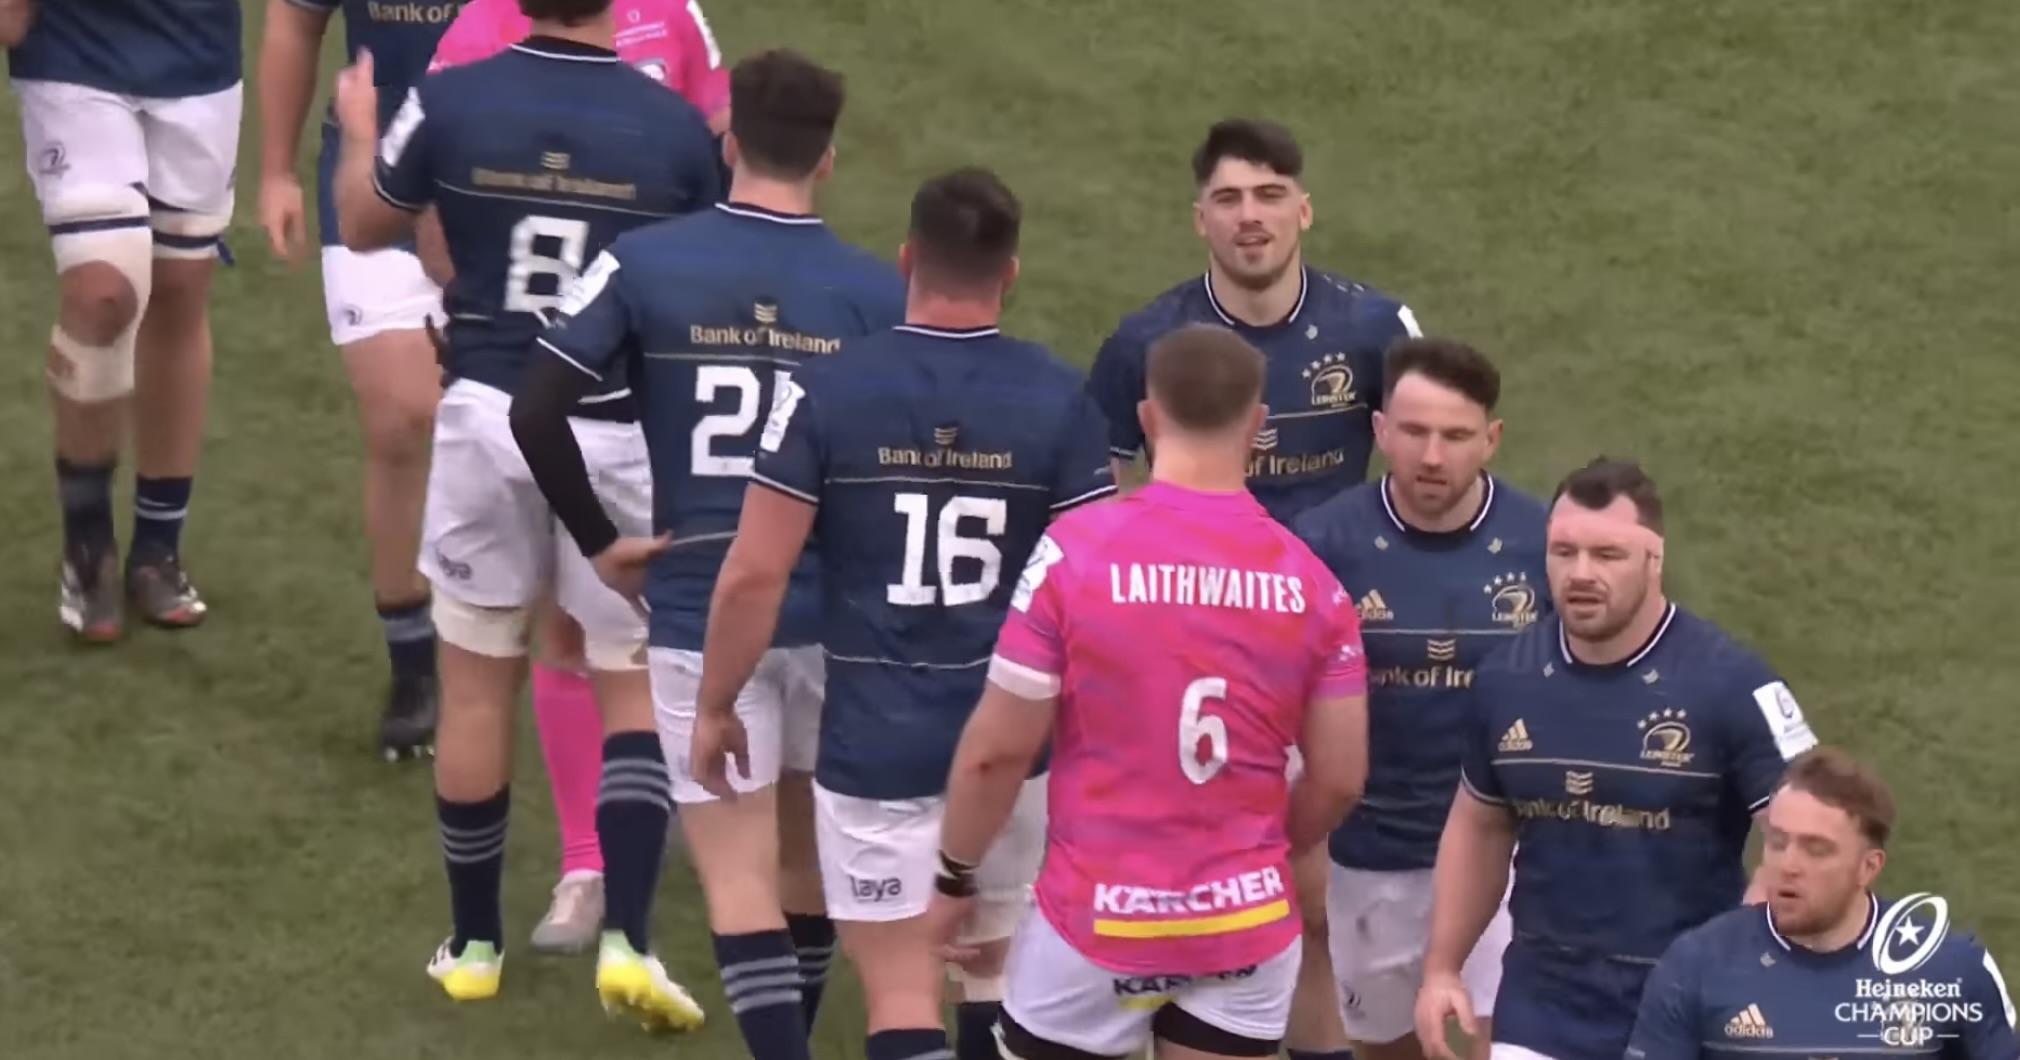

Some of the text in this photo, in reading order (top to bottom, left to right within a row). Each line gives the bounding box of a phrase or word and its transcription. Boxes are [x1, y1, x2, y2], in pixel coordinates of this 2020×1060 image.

[504, 215, 590, 313] 8
[690, 325, 741, 345] Bank
[945, 448, 1013, 471] Ireland
[1269, 448, 1344, 476] Ireland
[887, 493, 1007, 606] 16
[1110, 562, 1306, 614] LAITHWAITES
[1413, 665, 1441, 687] of
[1178, 677, 1228, 784] 6
[1583, 800, 1670, 830] Ireland
[851, 873, 902, 902] laya
